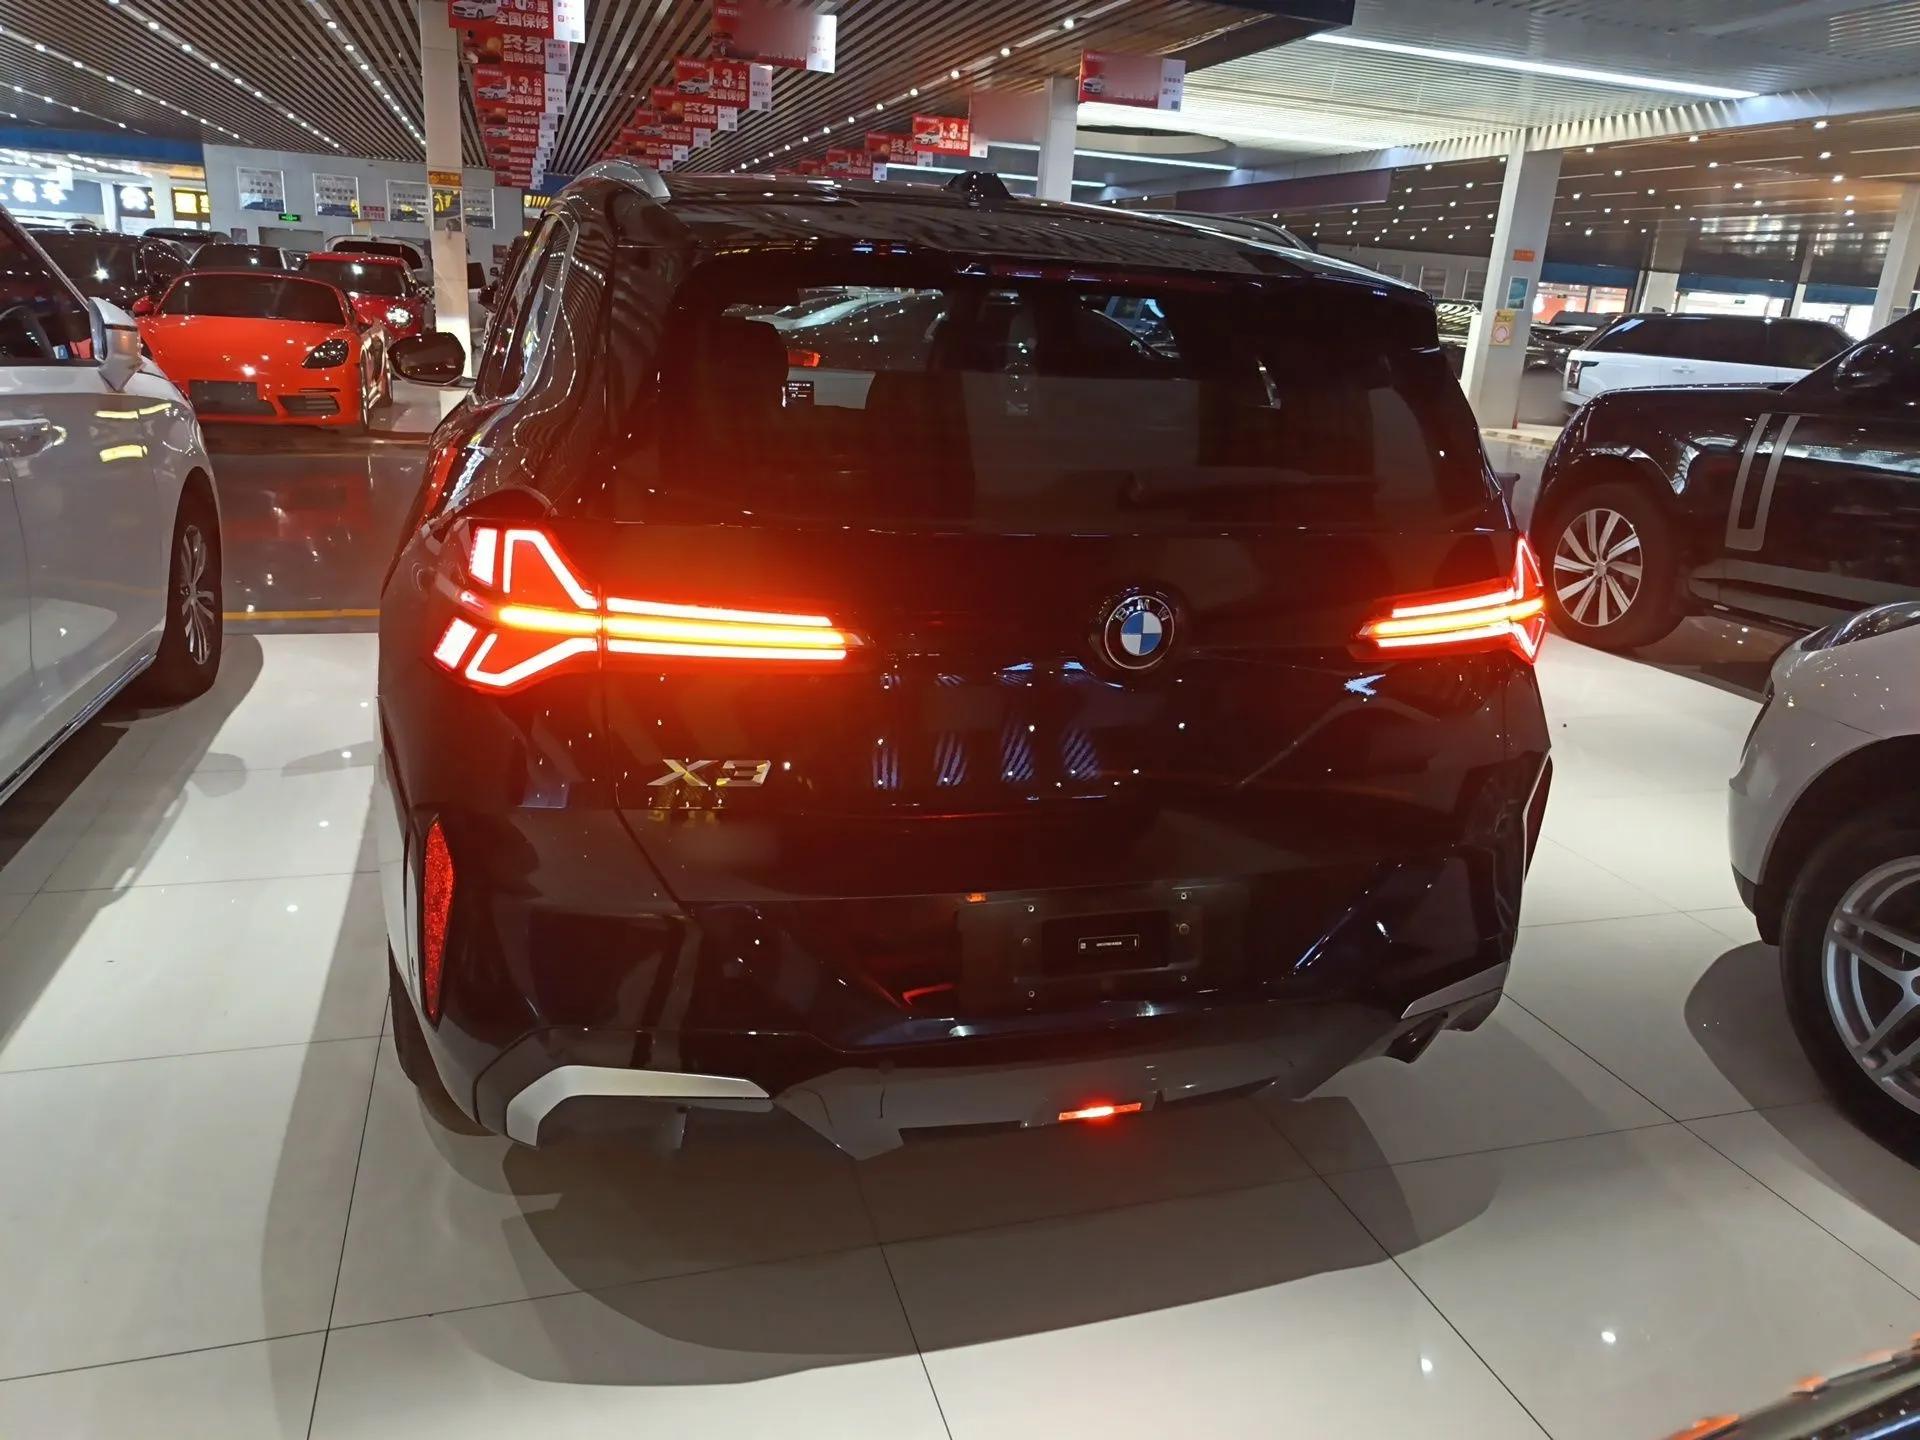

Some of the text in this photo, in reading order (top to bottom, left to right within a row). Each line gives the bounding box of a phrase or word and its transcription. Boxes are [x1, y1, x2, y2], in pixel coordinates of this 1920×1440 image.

[495, 10, 549, 29] 全国保修
[1115, 598, 1170, 623] BMW
[646, 758, 772, 787] X3
